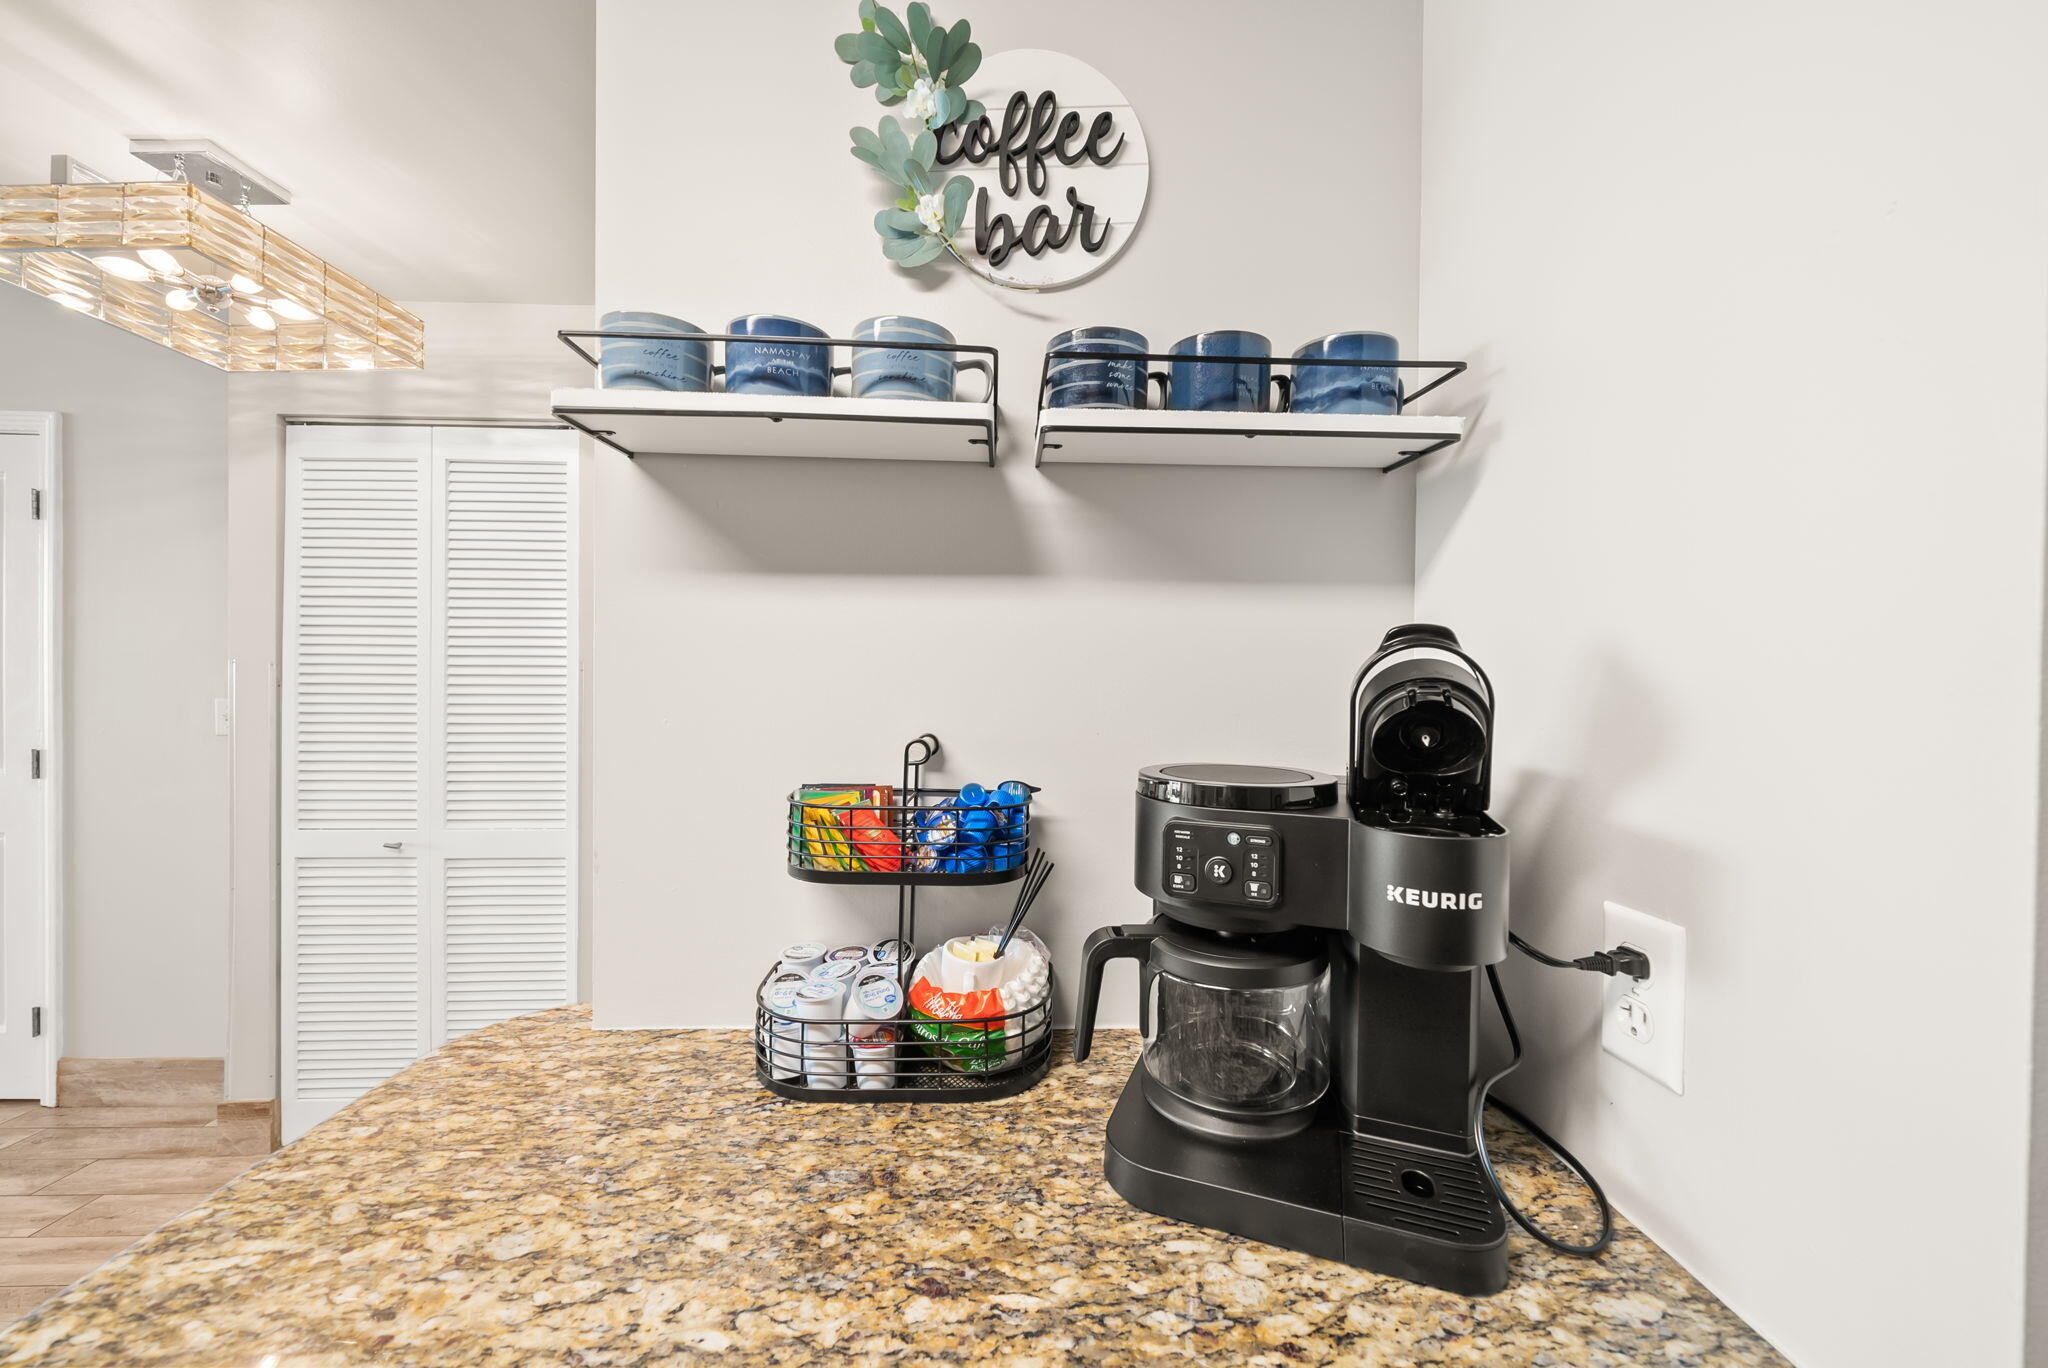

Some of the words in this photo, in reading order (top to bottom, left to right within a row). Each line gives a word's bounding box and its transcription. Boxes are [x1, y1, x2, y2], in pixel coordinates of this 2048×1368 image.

[935, 90, 1125, 197] coffee
[974, 186, 1111, 267] bar
[643, 348, 681, 361] coffee
[886, 350, 919, 361] coffee
[767, 366, 799, 377] BEACH
[1386, 884, 1483, 910] KEURIG
